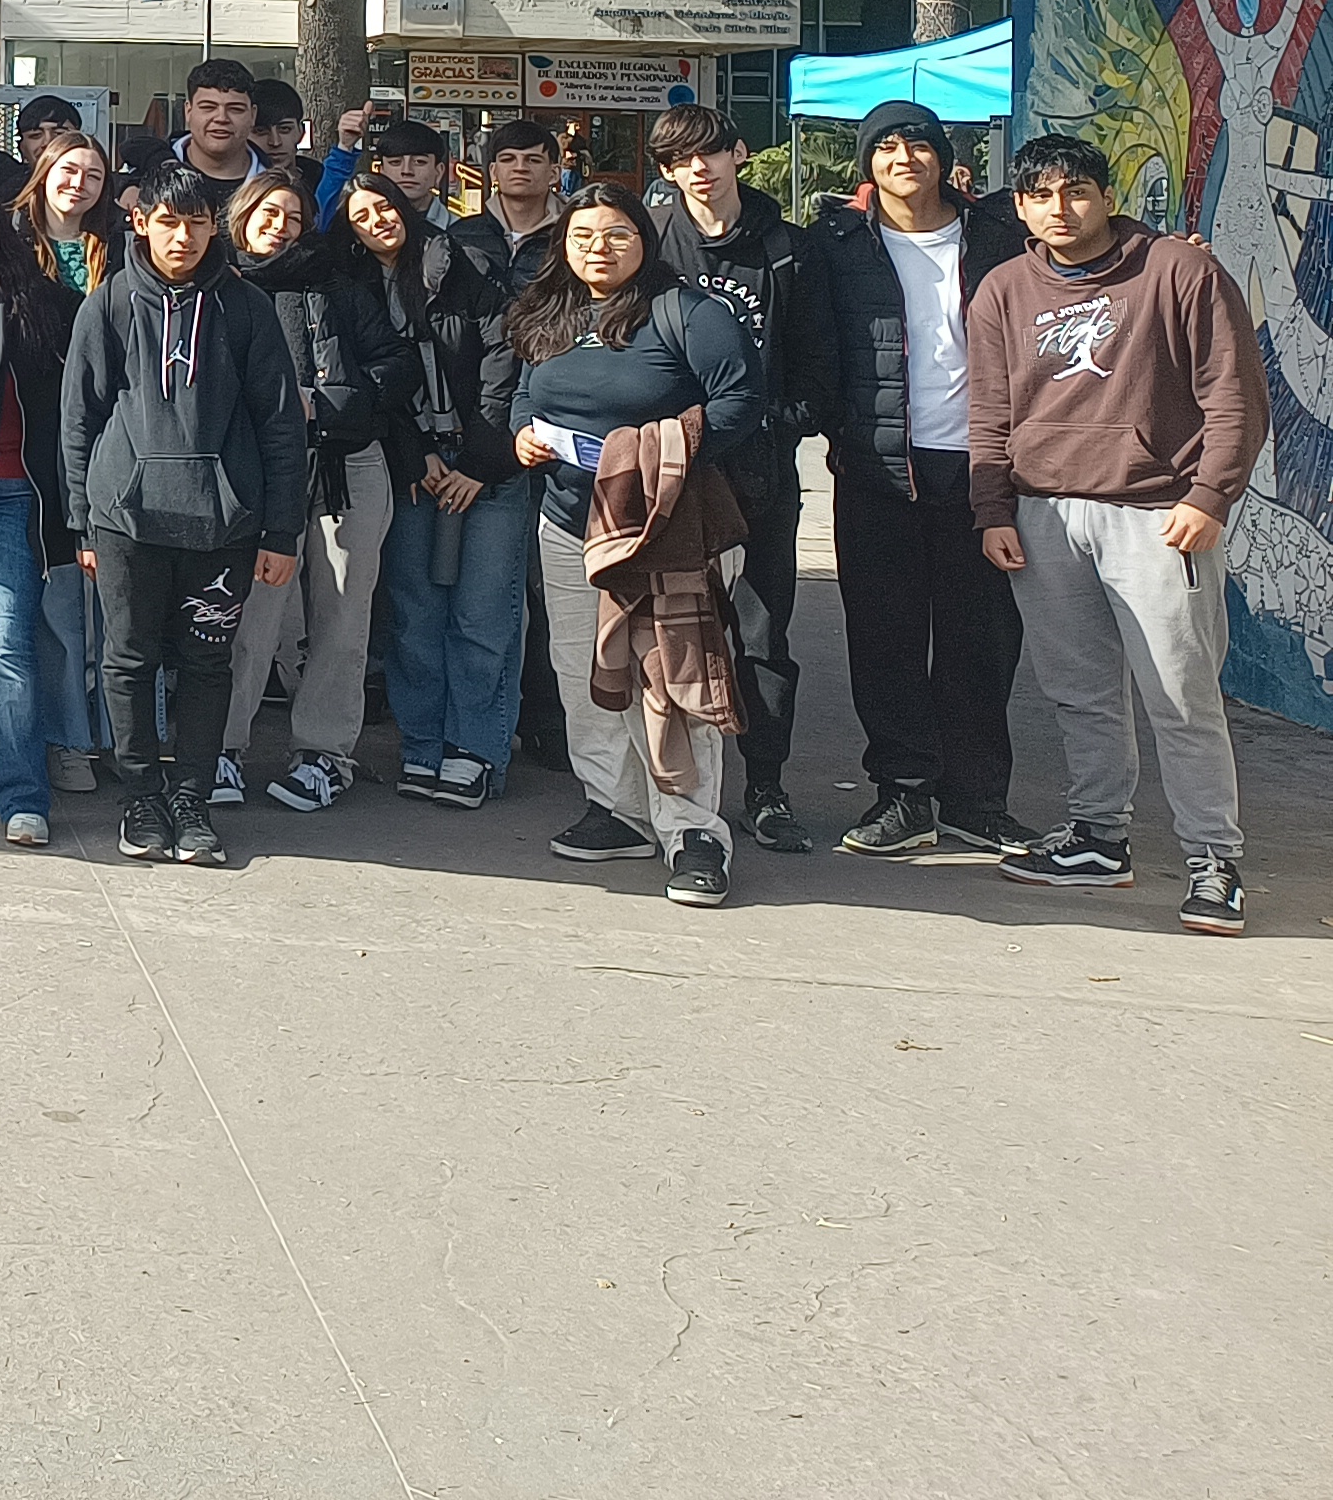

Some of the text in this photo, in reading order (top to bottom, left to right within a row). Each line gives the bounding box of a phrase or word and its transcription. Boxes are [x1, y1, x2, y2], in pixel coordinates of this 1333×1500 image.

[411, 66, 475, 80] GRACIAS
[558, 59, 669, 73] ENCUENTRO REGIONAL
[554, 70, 609, 80] JUBILADOS
[620, 72, 689, 83] PENSIONADOS
[698, 274, 761, 309] OCEAN
[1056, 295, 1112, 318] JORDAN
